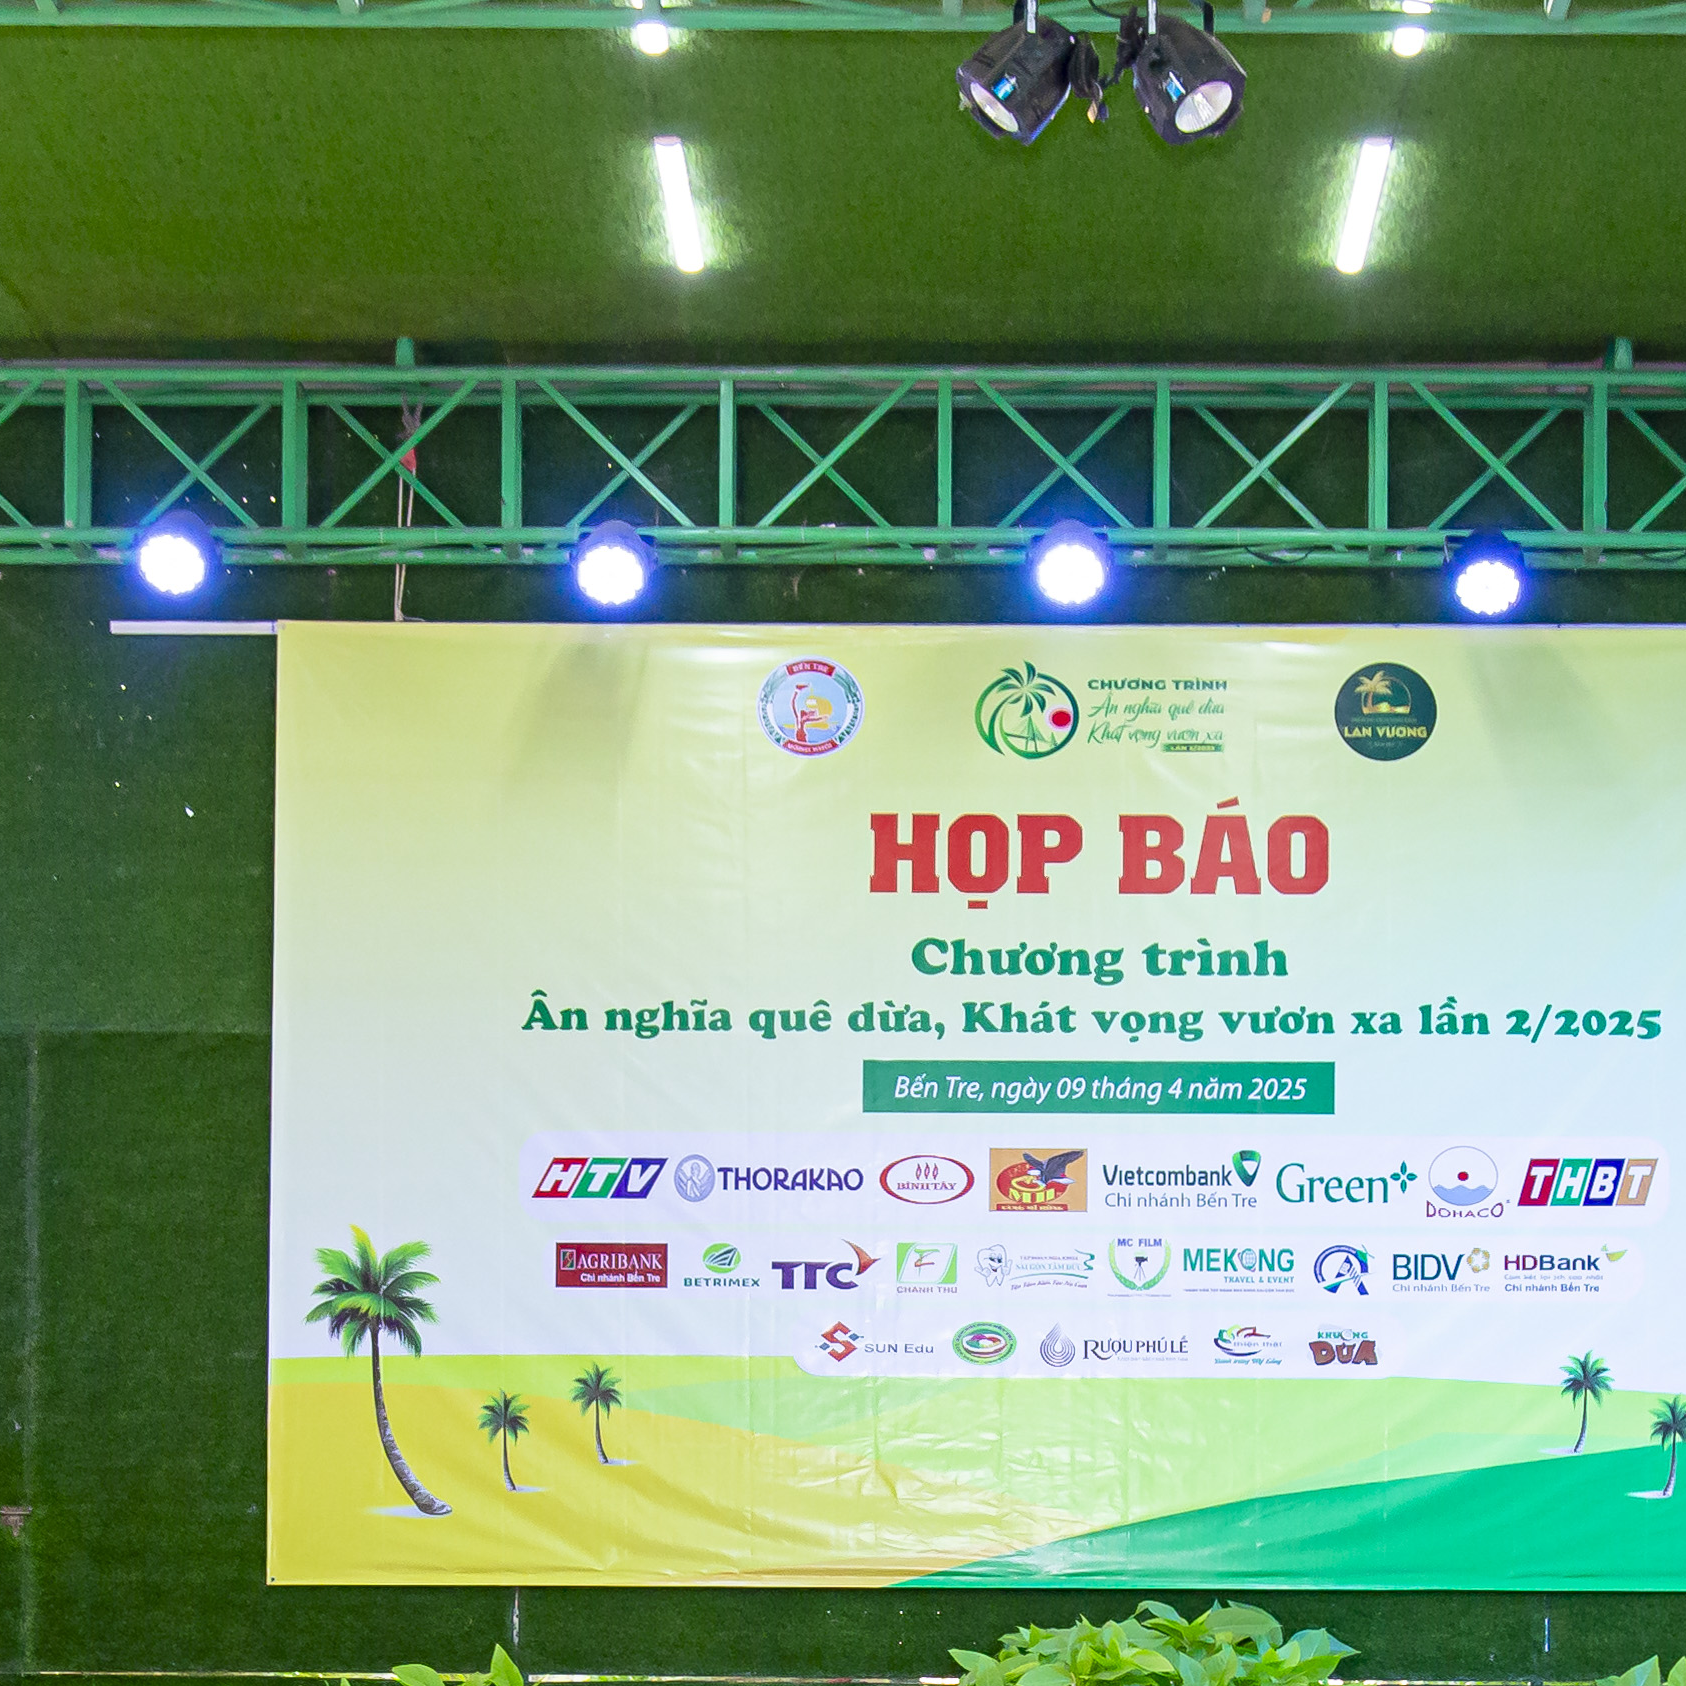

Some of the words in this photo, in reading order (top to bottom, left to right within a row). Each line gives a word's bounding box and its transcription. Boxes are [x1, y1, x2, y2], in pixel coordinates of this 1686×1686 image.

[1087, 677, 1166, 690] CHƯƠNG
[1172, 677, 1228, 691] TRÌNH
[1344, 726, 1373, 738] LAN
[869, 813, 1083, 909] HỌP
[1118, 795, 1330, 896] BÁO
[912, 937, 1125, 986] Chương
[1141, 937, 1290, 977] trình
[521, 989, 590, 1031] Ân
[604, 999, 733, 1040] nghĩa
[748, 999, 832, 1040] quê
[847, 1000, 946, 1040] dừa,
[961, 1000, 1077, 1033] Khát
[1091, 1007, 1204, 1043] vọng
[1217, 1006, 1335, 1034] vươn
[1350, 1011, 1404, 1035] xa
[1418, 996, 1491, 1036] lần
[1505, 1003, 1662, 1044] 2/2025
[894, 1073, 941, 1099] Bến
[944, 1076, 986, 1103] Tre,
[990, 1076, 1051, 1105] ngày
[1056, 1077, 1087, 1100] 09
[1091, 1077, 1164, 1105] tháng
[1167, 1079, 1183, 1100] 4
[1188, 1077, 1243, 1100] năm
[1248, 1078, 1309, 1101] 2025
[535, 1160, 665, 1196] HTV
[717, 1167, 864, 1191] THORAKAO
[1102, 1164, 1233, 1187] Vietcombank
[1524, 1162, 1654, 1202] THBT
[1104, 1192, 1132, 1208] Chi
[1137, 1192, 1191, 1208] nhánh
[1196, 1192, 1228, 1208] Bến
[1231, 1193, 1258, 1208] Tre
[1425, 1200, 1504, 1219] DOHACO
[1117, 1238, 1133, 1248] MC
[1138, 1238, 1163, 1248] FILM
[576, 1253, 663, 1270] AGRIBANK
[1183, 1248, 1295, 1272] MEKONG
[1392, 1253, 1465, 1281] BIDV
[1504, 1254, 1601, 1271] HDBank
[684, 1277, 761, 1288] BETRIMEX
[771, 1261, 859, 1290] TTC
[1224, 1276, 1255, 1284] TRAVEL
[1268, 1276, 1295, 1284] EVENT
[1504, 1282, 1523, 1293] Chi
[1525, 1282, 1558, 1293] nhánh
[1560, 1281, 1581, 1293] Bến
[1584, 1283, 1600, 1293] Tre
[1392, 1283, 1411, 1293] Chi
[1413, 1283, 1448, 1293] nhánh
[1451, 1282, 1472, 1293] Bến
[1473, 1283, 1491, 1293] Tre
[864, 1343, 898, 1353] SUN
[904, 1343, 934, 1353] Edu
[1083, 1337, 1133, 1361] RƯỢU
[1136, 1336, 1168, 1354] PHÚ
[1309, 1340, 1379, 1366] DỪA
